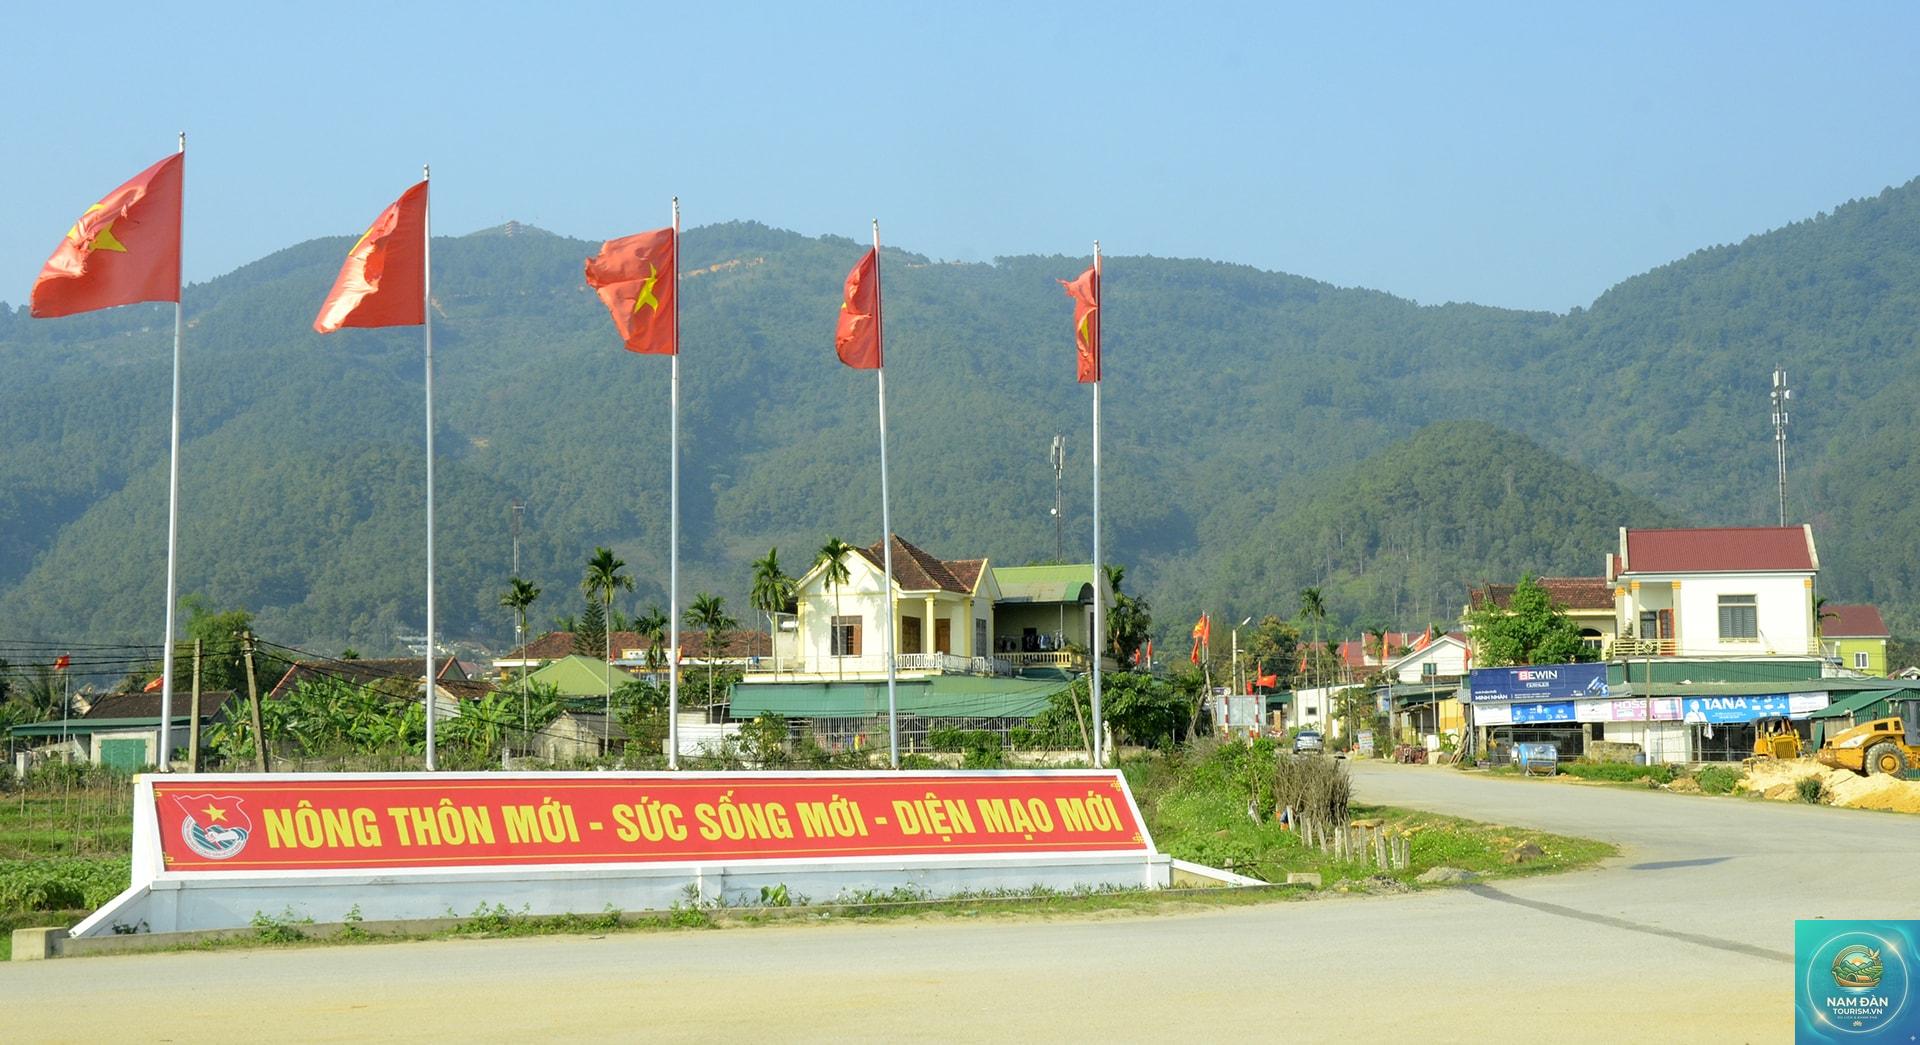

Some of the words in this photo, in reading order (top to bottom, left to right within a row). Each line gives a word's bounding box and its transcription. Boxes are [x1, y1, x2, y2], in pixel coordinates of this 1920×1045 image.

[1519, 670, 1558, 680] BEWIN
[1702, 697, 1748, 710] TANA
[263, 800, 382, 848] NÔNG
[388, 798, 496, 846] THÔN
[502, 797, 581, 844] MỚI
[612, 796, 688, 842] SỨC
[694, 790, 794, 841] SỐNG
[796, 794, 869, 838] MỚI
[892, 792, 977, 842] DIỆN
[976, 798, 1055, 841] MẠO
[1055, 790, 1124, 832] MỚI
